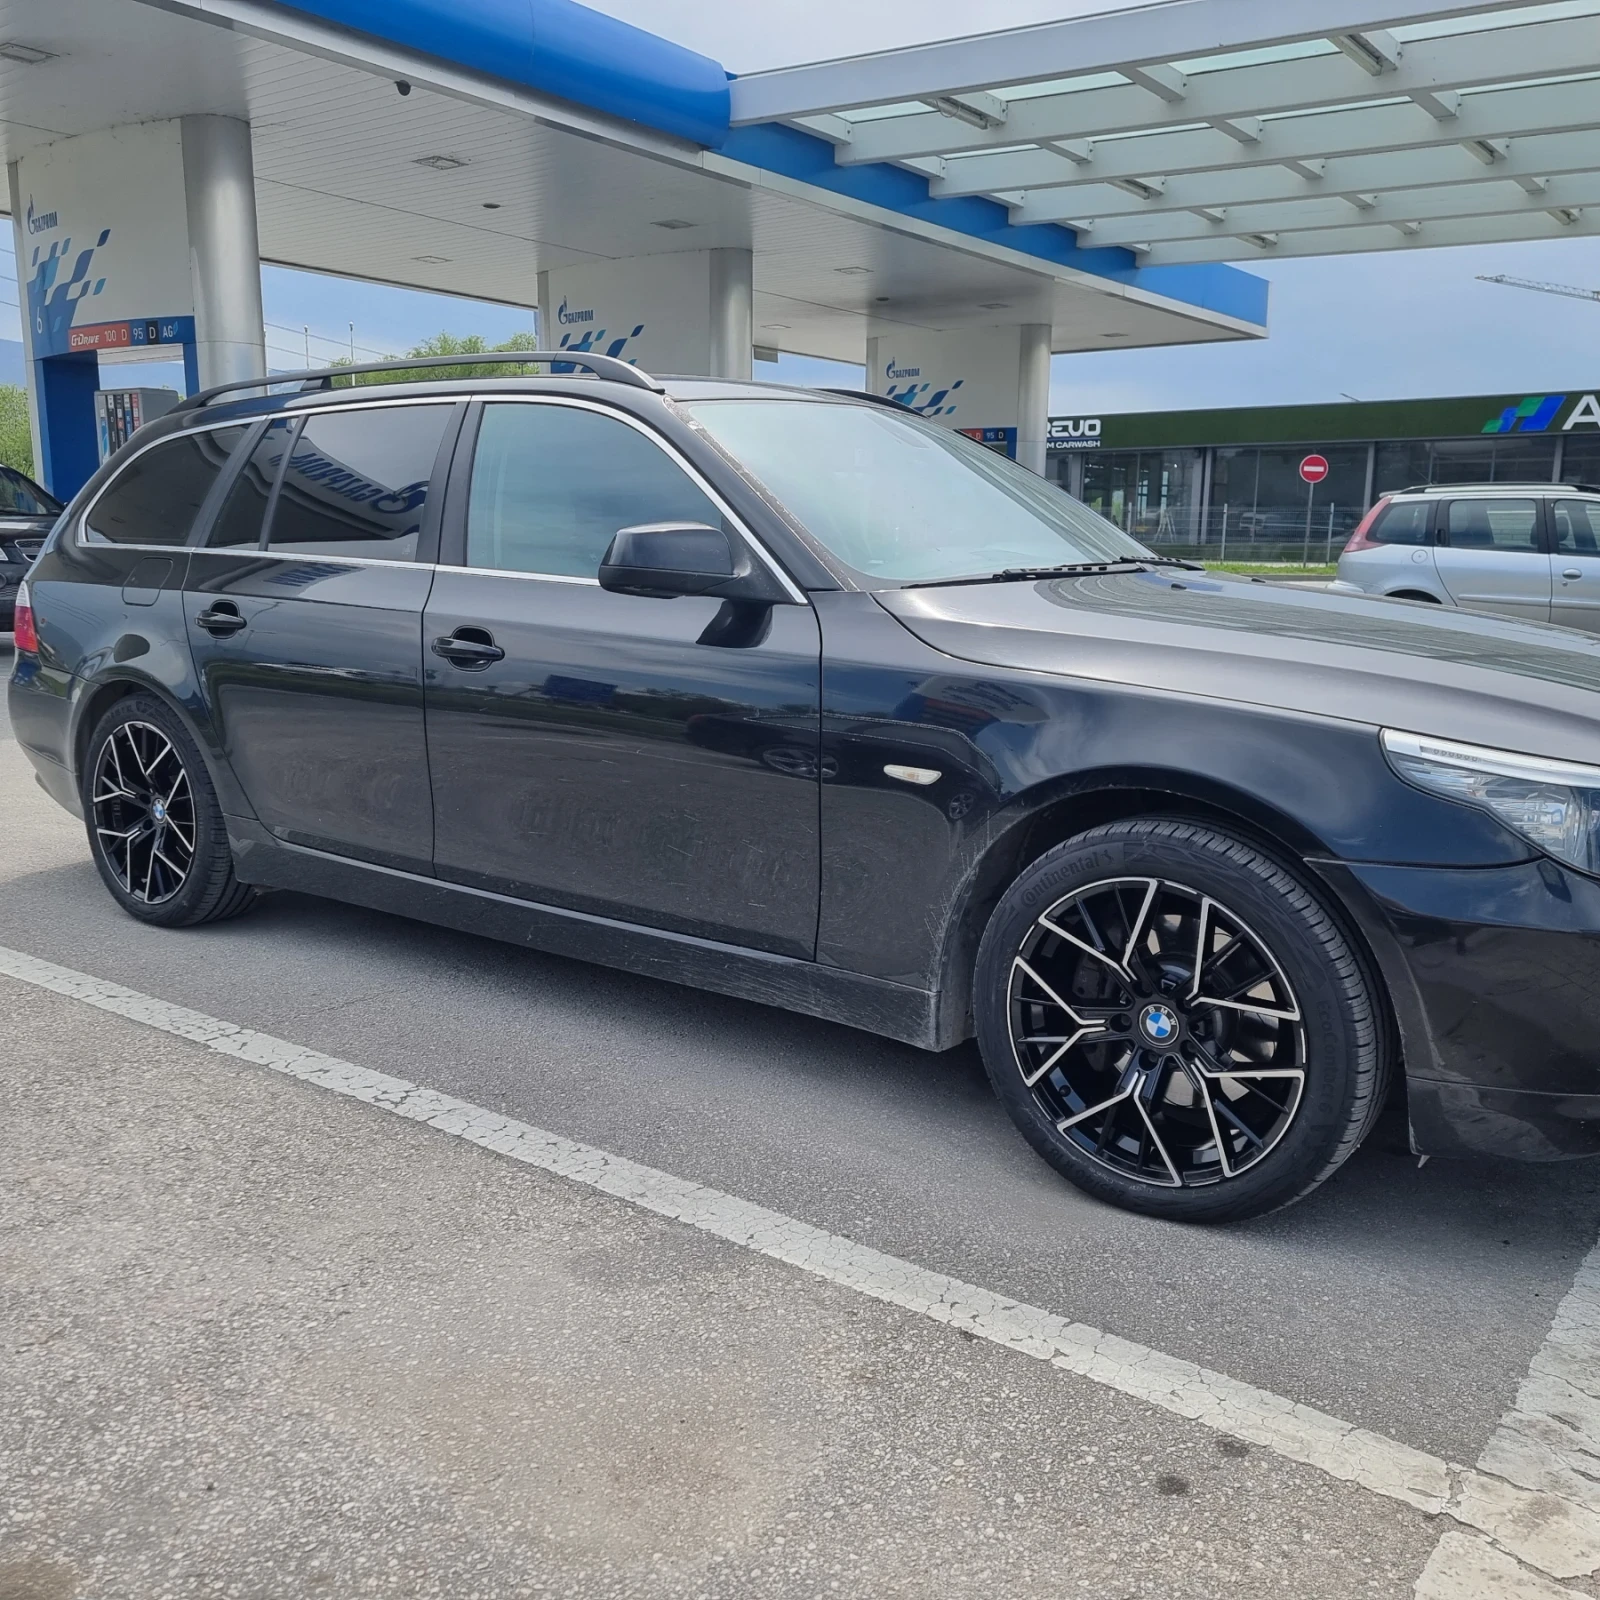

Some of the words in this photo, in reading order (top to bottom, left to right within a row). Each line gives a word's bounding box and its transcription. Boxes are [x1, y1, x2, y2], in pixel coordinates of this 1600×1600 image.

[36, 305, 43, 334] 6
[568, 309, 594, 324] GAZPROM
[104, 330, 117, 342] 100
[121, 329, 128, 341] D
[133, 328, 144, 340] 95
[149, 326, 156, 339] D
[162, 325, 174, 338] AG
[986, 431, 995, 439] 95
[998, 431, 1004, 439] D
[1055, 440, 1101, 449] CARWASH
[1021, 852, 1100, 908] Continental
